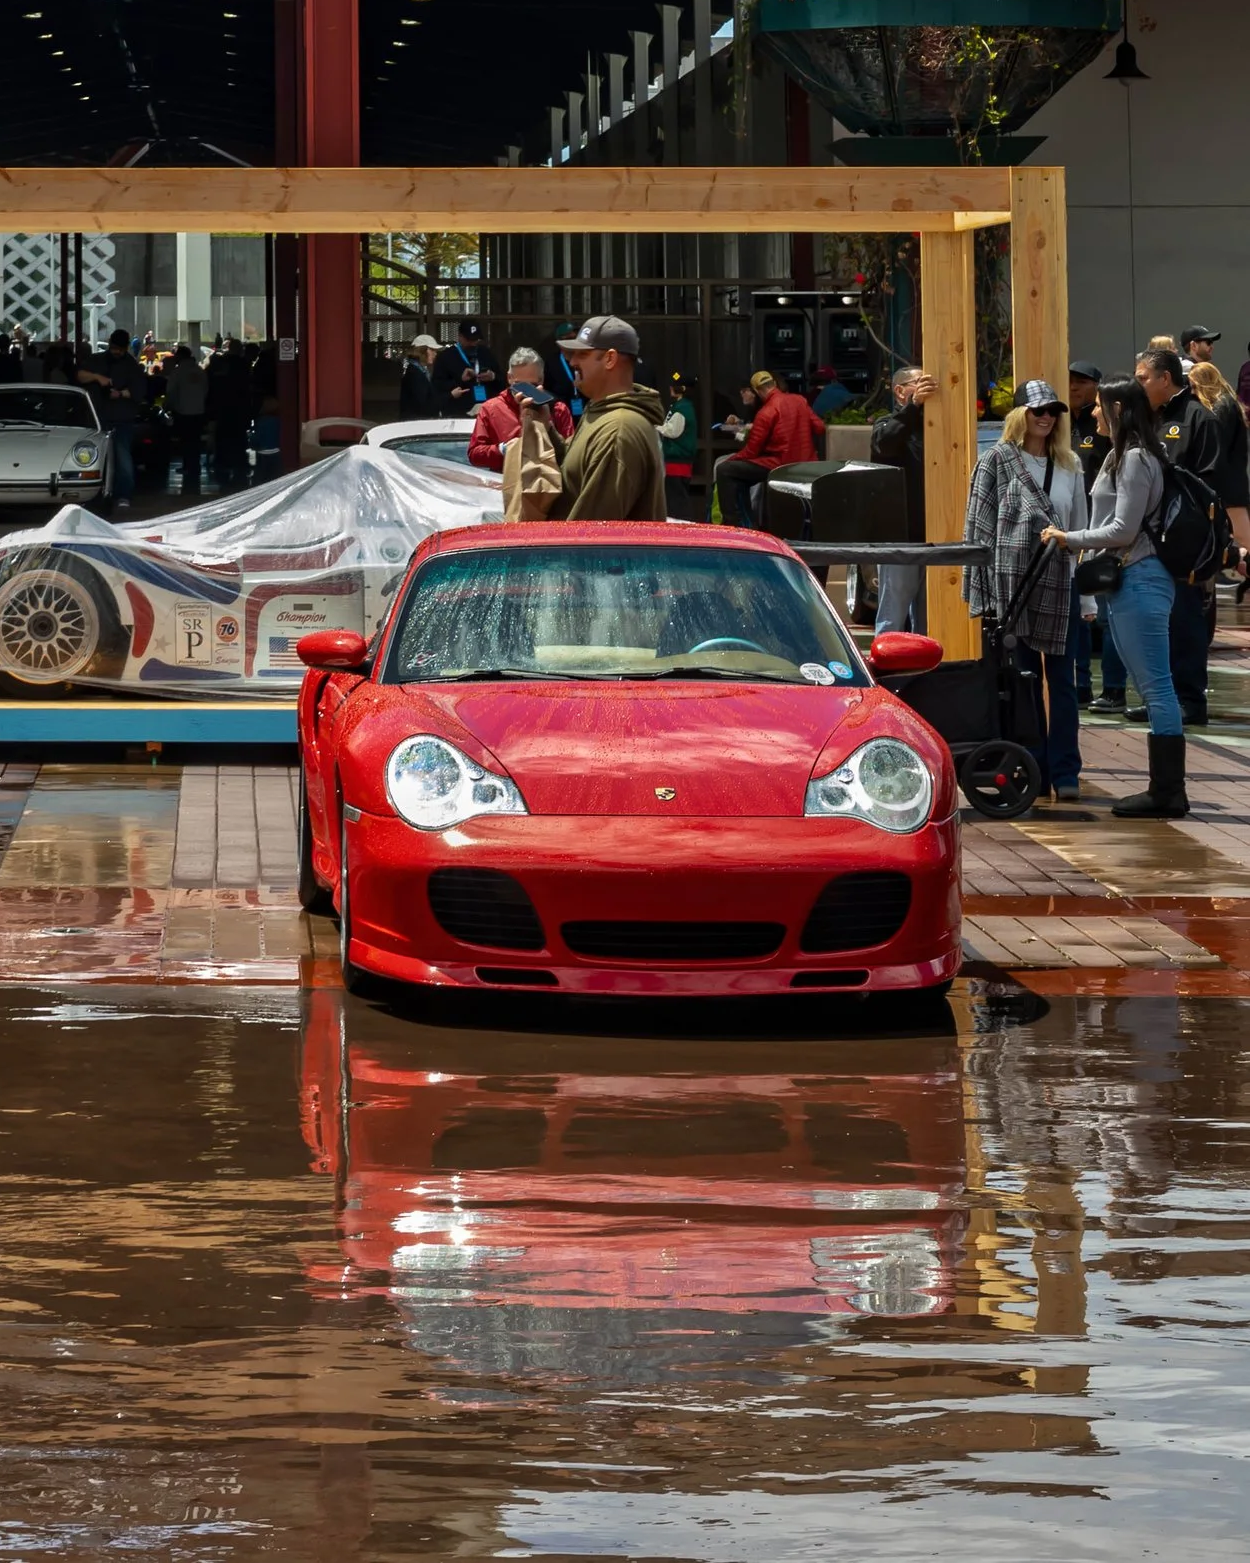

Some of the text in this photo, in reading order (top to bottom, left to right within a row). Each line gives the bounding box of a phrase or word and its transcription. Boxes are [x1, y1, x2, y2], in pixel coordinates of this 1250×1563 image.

[183, 618, 203, 630] SR
[276, 611, 326, 624] Champion
[220, 622, 235, 636] 76
[184, 631, 204, 659] P
